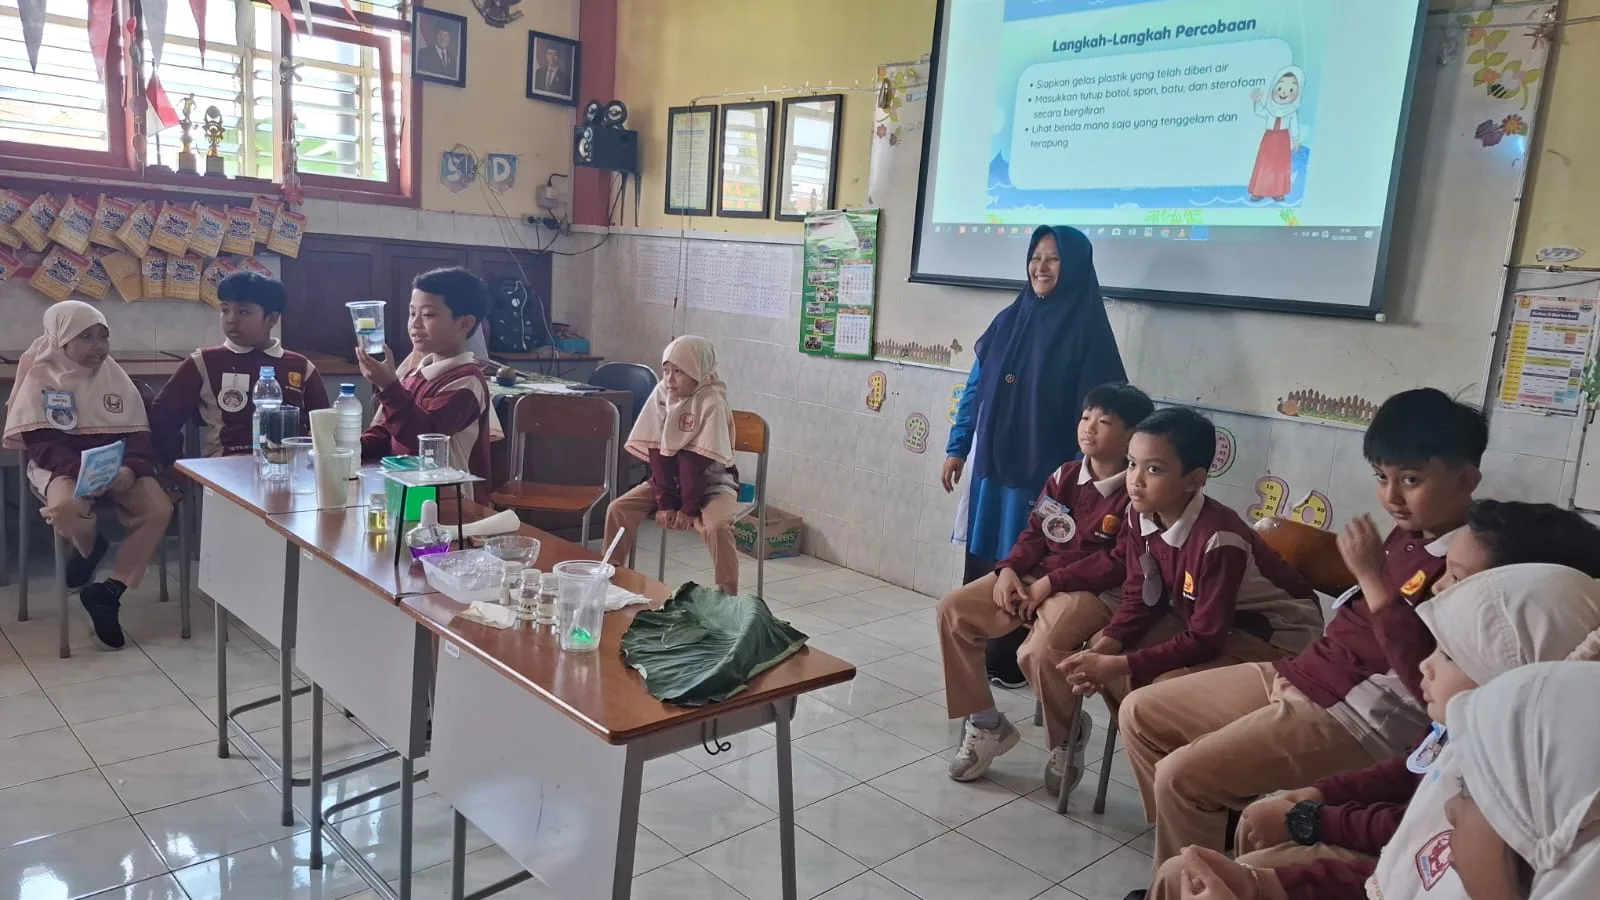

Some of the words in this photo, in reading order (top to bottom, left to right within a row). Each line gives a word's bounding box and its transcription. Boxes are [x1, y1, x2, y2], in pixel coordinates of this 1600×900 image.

[1052, 26, 1171, 53] Langkah-Langkah
[1175, 18, 1256, 39] Percobaan
[1036, 78, 1070, 89] Siapkan
[1072, 76, 1096, 88] gelas
[1098, 72, 1128, 86] plastik
[1130, 71, 1155, 83] yang
[1157, 67, 1182, 79] telah
[1184, 64, 1213, 76] diberi
[1215, 63, 1229, 73] air
[1035, 93, 1078, 104] Masukkan
[1080, 91, 1103, 102] tutup
[1105, 87, 1131, 98] botol,
[1133, 86, 1159, 97] spon,
[1161, 83, 1186, 95] batu,
[1188, 81, 1208, 92] dan
[1210, 77, 1267, 90] sterofoam
[1032, 123, 1052, 134] Lihat
[1054, 122, 1081, 133] benda
[1083, 121, 1110, 130] mana
[1112, 119, 1131, 130] saja
[1133, 118, 1158, 129] yang
[1160, 114, 1215, 128] tenggelam
[1217, 112, 1238, 122] dan
[1033, 109, 1062, 119] secara
[1063, 105, 1105, 118] bergiliran
[1030, 139, 1069, 150] terapung
[492, 157, 511, 182] D
